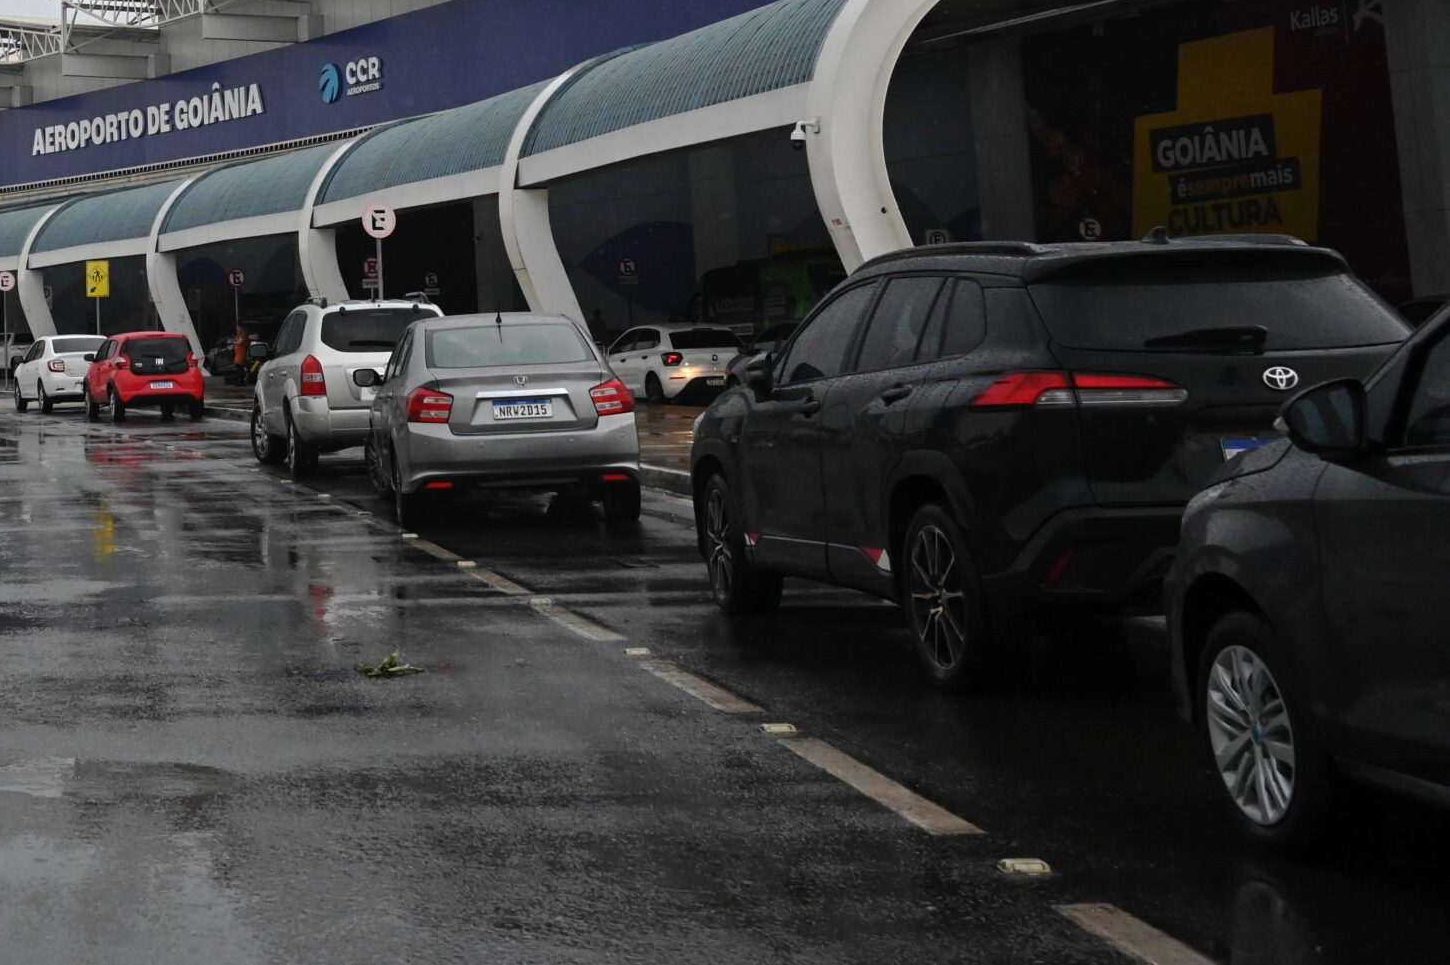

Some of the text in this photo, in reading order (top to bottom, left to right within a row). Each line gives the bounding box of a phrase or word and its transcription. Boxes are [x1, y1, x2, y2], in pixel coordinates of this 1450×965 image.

[1290, 5, 1338, 31] Kallas
[345, 56, 380, 85] CCR
[32, 82, 263, 156] AEROPORTO DE GOIÂNIA
[1156, 127, 1269, 168] GOIÂNIA
[1167, 196, 1284, 236] CULTURA
[499, 404, 547, 417] NRW2D15
